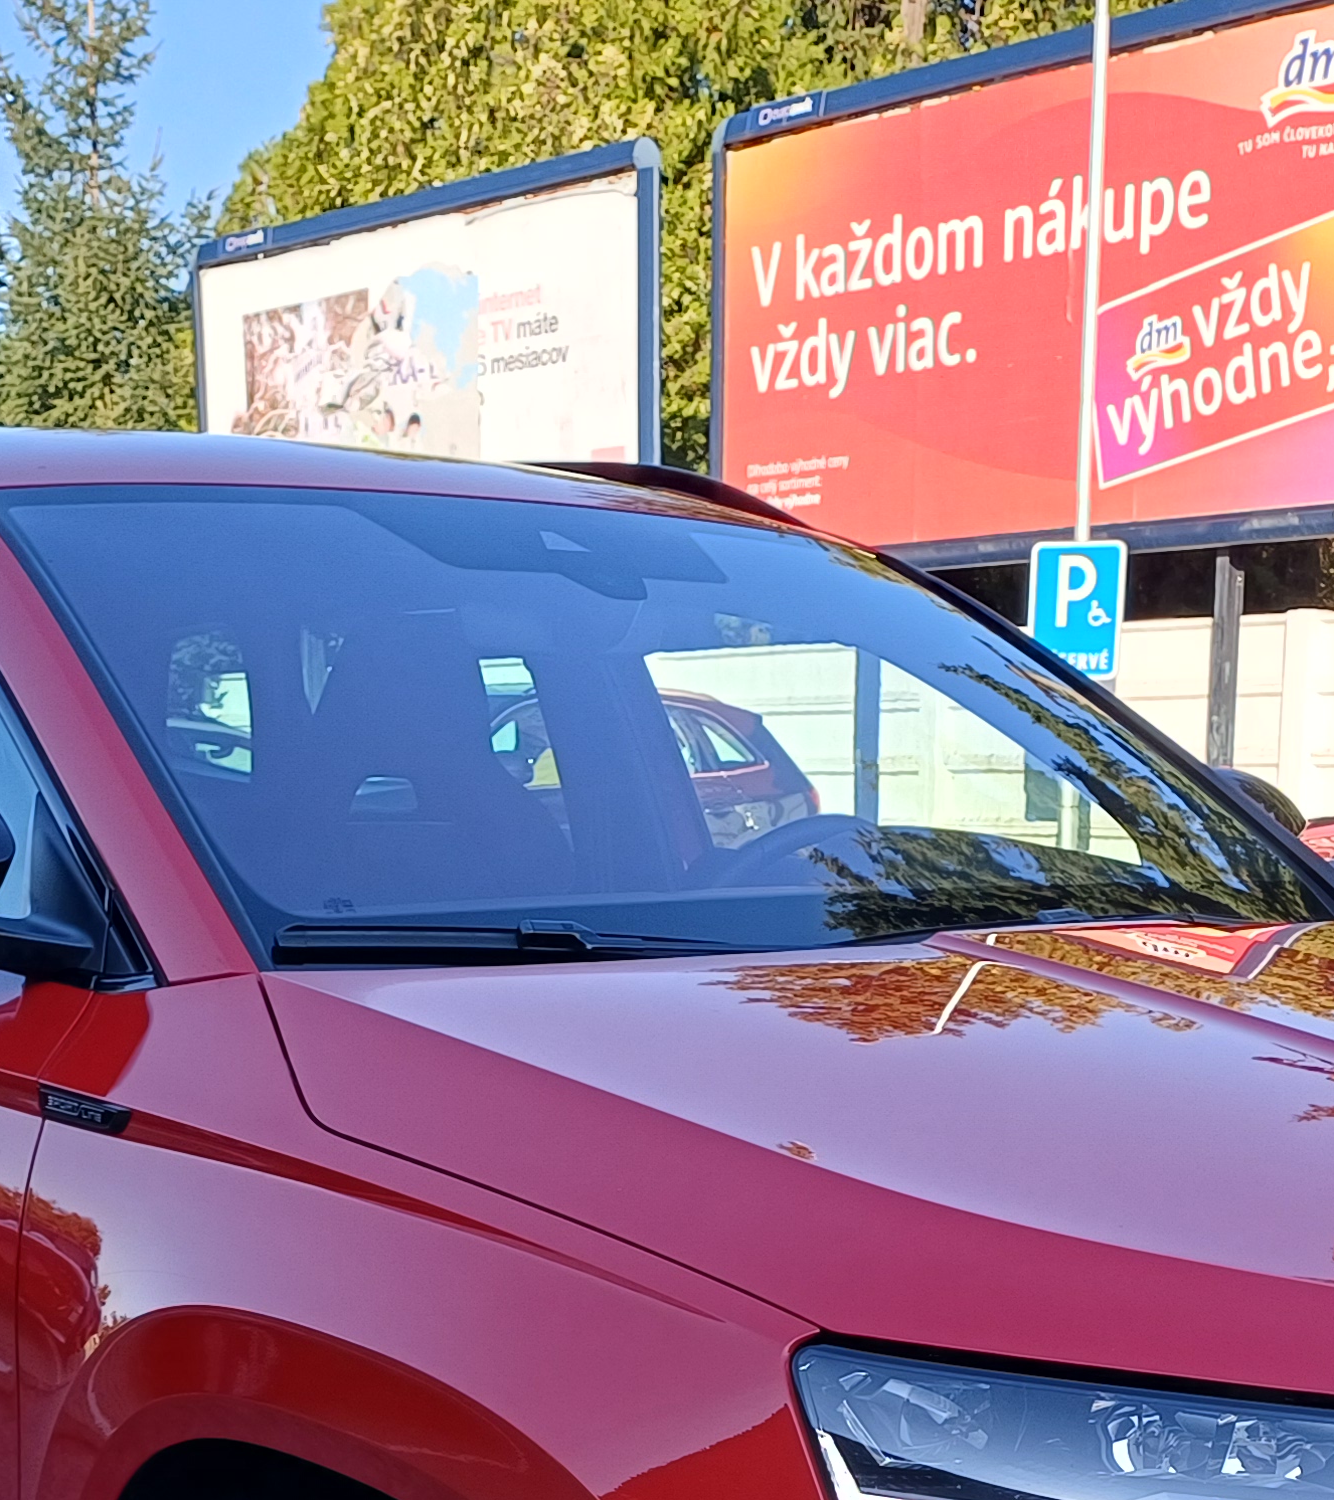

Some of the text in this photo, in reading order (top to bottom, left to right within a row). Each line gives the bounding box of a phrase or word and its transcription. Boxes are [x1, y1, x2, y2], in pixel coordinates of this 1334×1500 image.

[1238, 139, 1254, 156] TU
[1256, 130, 1281, 150] SOM
[1302, 145, 1317, 159] TU
[750, 169, 1212, 308] V každom nákupe
[490, 318, 513, 344] TV
[516, 311, 560, 340] máte
[1139, 261, 1311, 355] dm vždy
[490, 344, 570, 376] mesiacov
[750, 303, 977, 400] vždy viac.
[1054, 553, 1098, 629] P
